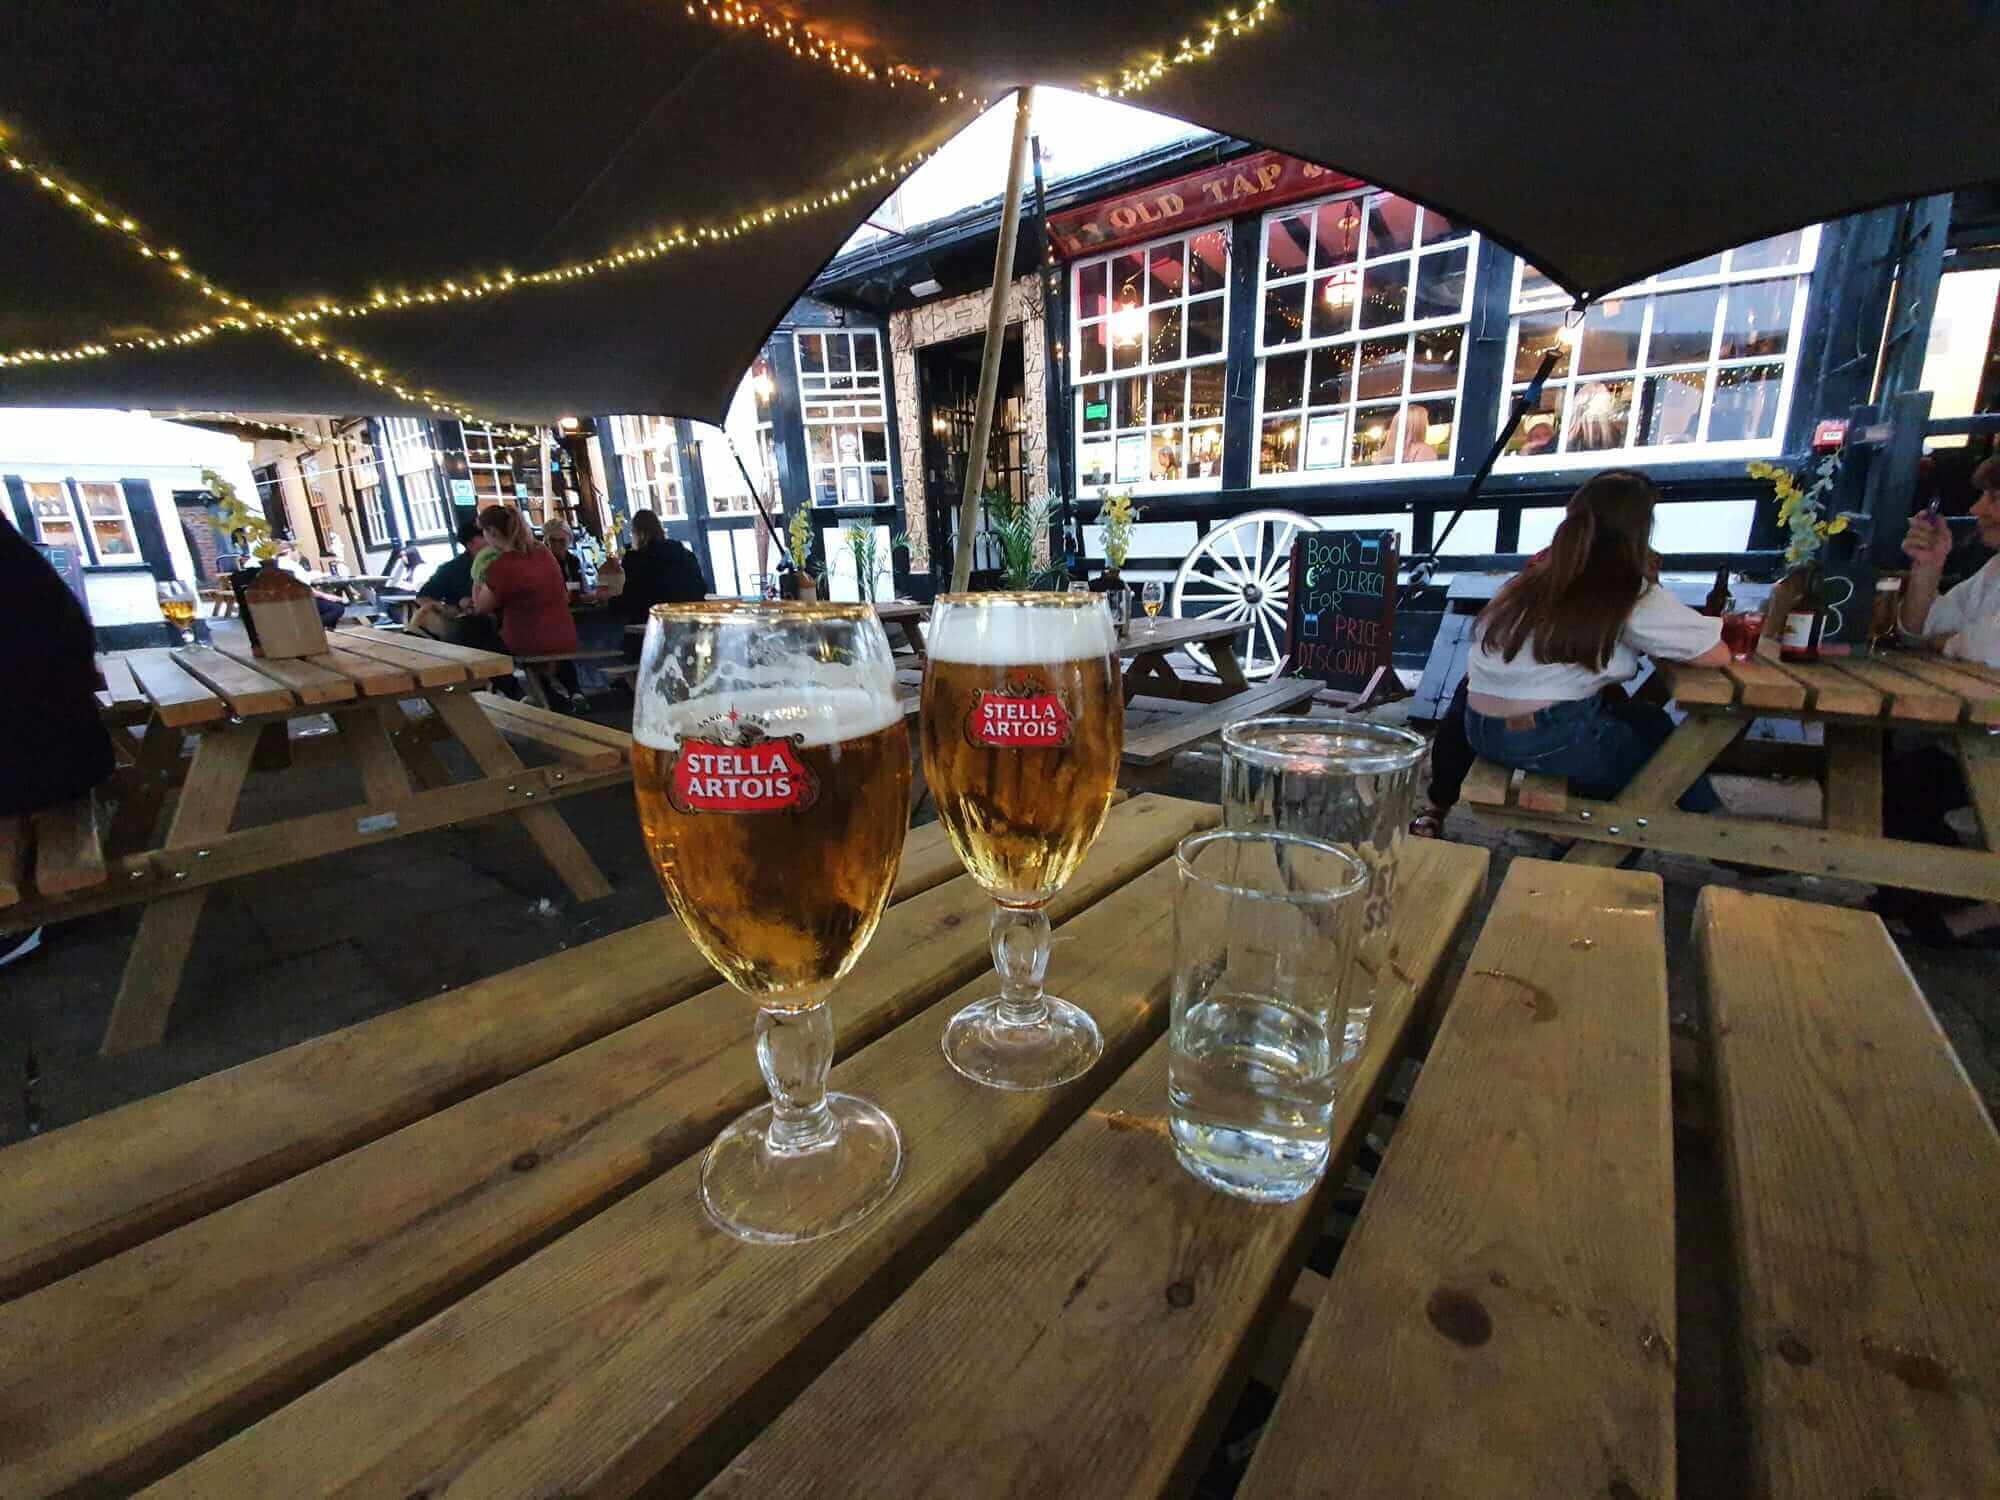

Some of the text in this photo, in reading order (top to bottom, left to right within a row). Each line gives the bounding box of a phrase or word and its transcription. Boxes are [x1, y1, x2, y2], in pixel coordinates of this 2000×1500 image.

[1109, 192, 1185, 228] OLD
[1202, 163, 1282, 203] TAP
[1309, 591, 1343, 611] FOR
[1336, 615, 1380, 646] PRICE
[1298, 642, 1377, 674] DISCOUNT
[984, 703, 1056, 720] STELLA
[983, 721, 1057, 737] ARTOIS
[688, 753, 788, 775] STELLA
[688, 776, 792, 799] ARTOIS
